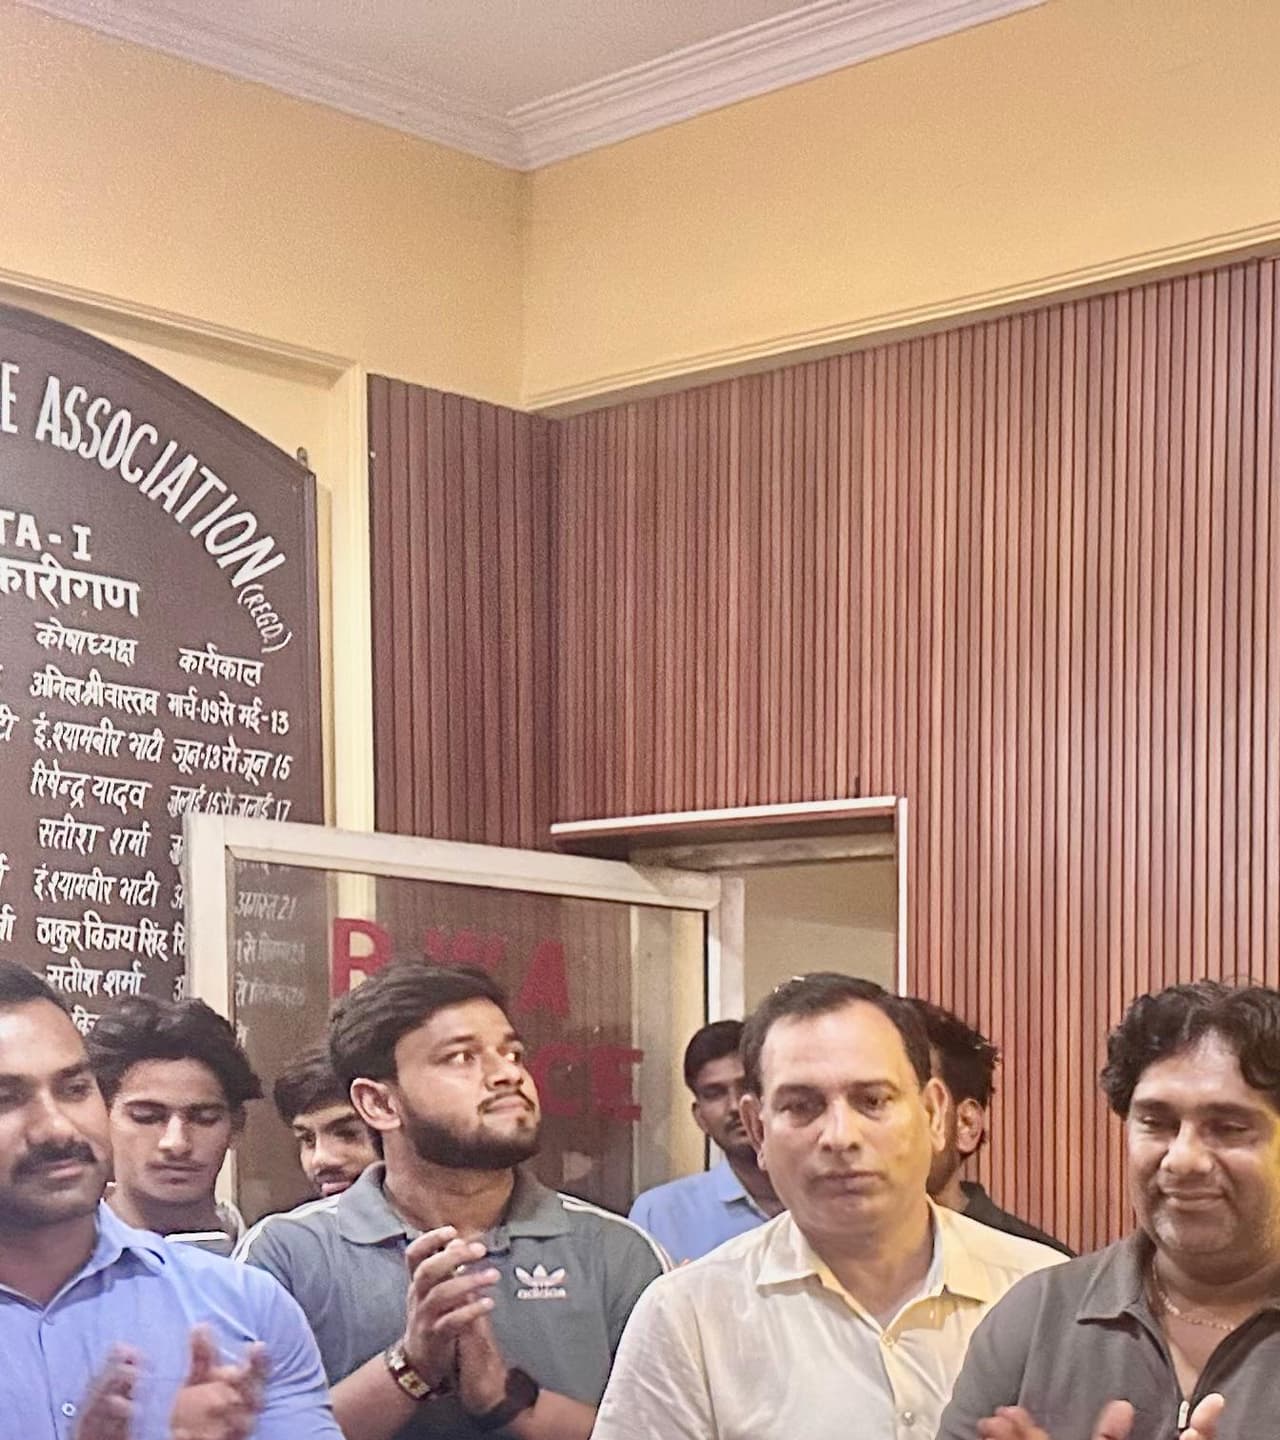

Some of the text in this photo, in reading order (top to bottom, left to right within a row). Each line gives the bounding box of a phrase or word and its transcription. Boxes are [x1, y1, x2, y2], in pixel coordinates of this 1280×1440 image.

[35, 376, 286, 588] ASSOCIATION
[34, 617, 264, 687] कोषाध्यक्ष कार्यकाल
[92, 776, 152, 815] यादव
[109, 821, 151, 857] शर्मा
[119, 870, 160, 907] भाटी
[82, 910, 138, 951] विजय
[102, 960, 146, 998] शर्मा
